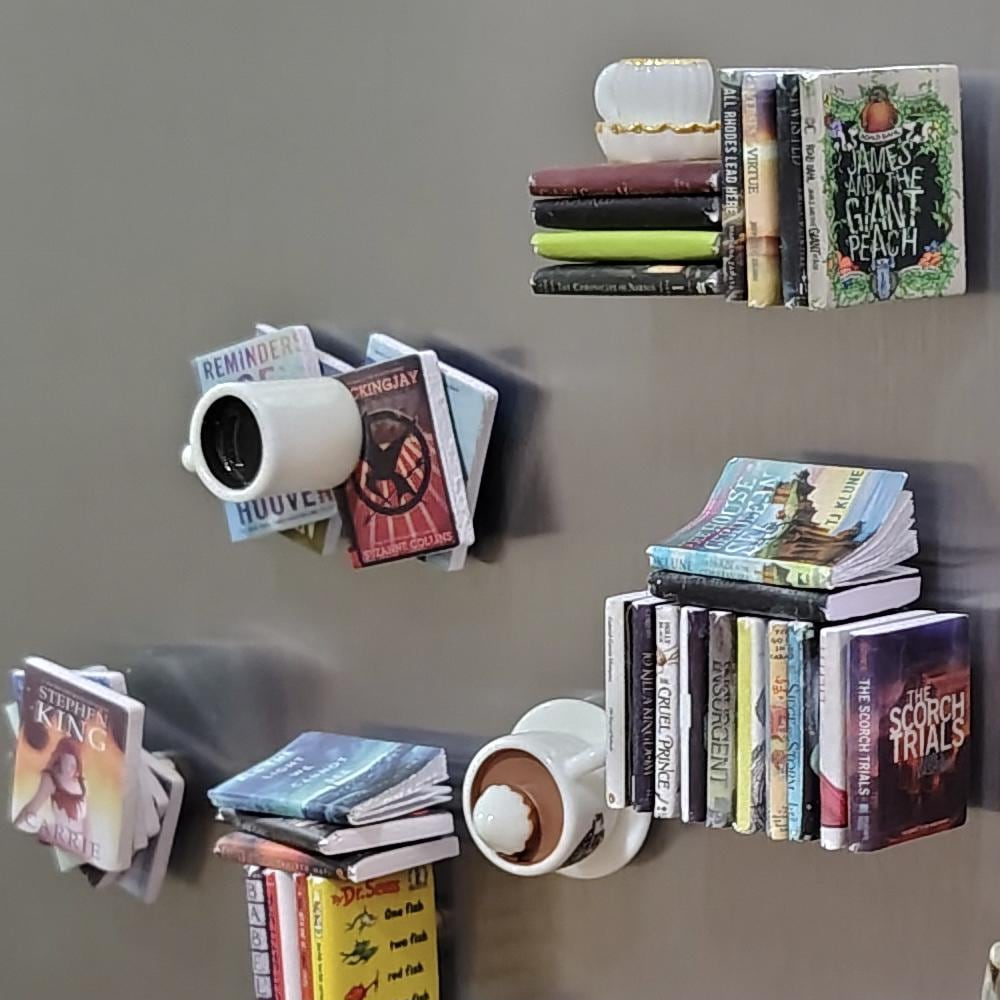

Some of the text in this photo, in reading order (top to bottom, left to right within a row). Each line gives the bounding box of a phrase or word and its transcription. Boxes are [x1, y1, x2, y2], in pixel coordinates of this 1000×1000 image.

[723, 88, 740, 215] ALL RHODES LEAD HERE
[746, 147, 760, 195] VIRTUE
[846, 141, 912, 175] JAMES
[844, 166, 925, 197] AND THE
[845, 189, 925, 234] GIANT
[847, 223, 918, 262] PEACH
[350, 369, 419, 400] CKINGJAY
[835, 469, 865, 509] KLUNE
[657, 686, 672, 730] CRUEL
[888, 691, 966, 735] SCORCH
[906, 685, 932, 706] THE
[36, 700, 108, 752] KING
[709, 660, 732, 788] INSURGENT
[858, 679, 871, 796] THE SCORCH TRIALS
[888, 719, 966, 764] TRIALS
[657, 734, 675, 791] PRINCE
[25, 813, 102, 860] CARRIE
[343, 886, 364, 908] Dr.
[405, 899, 424, 915] fish
[389, 929, 428, 952] two fish
[387, 961, 424, 983] red fish
